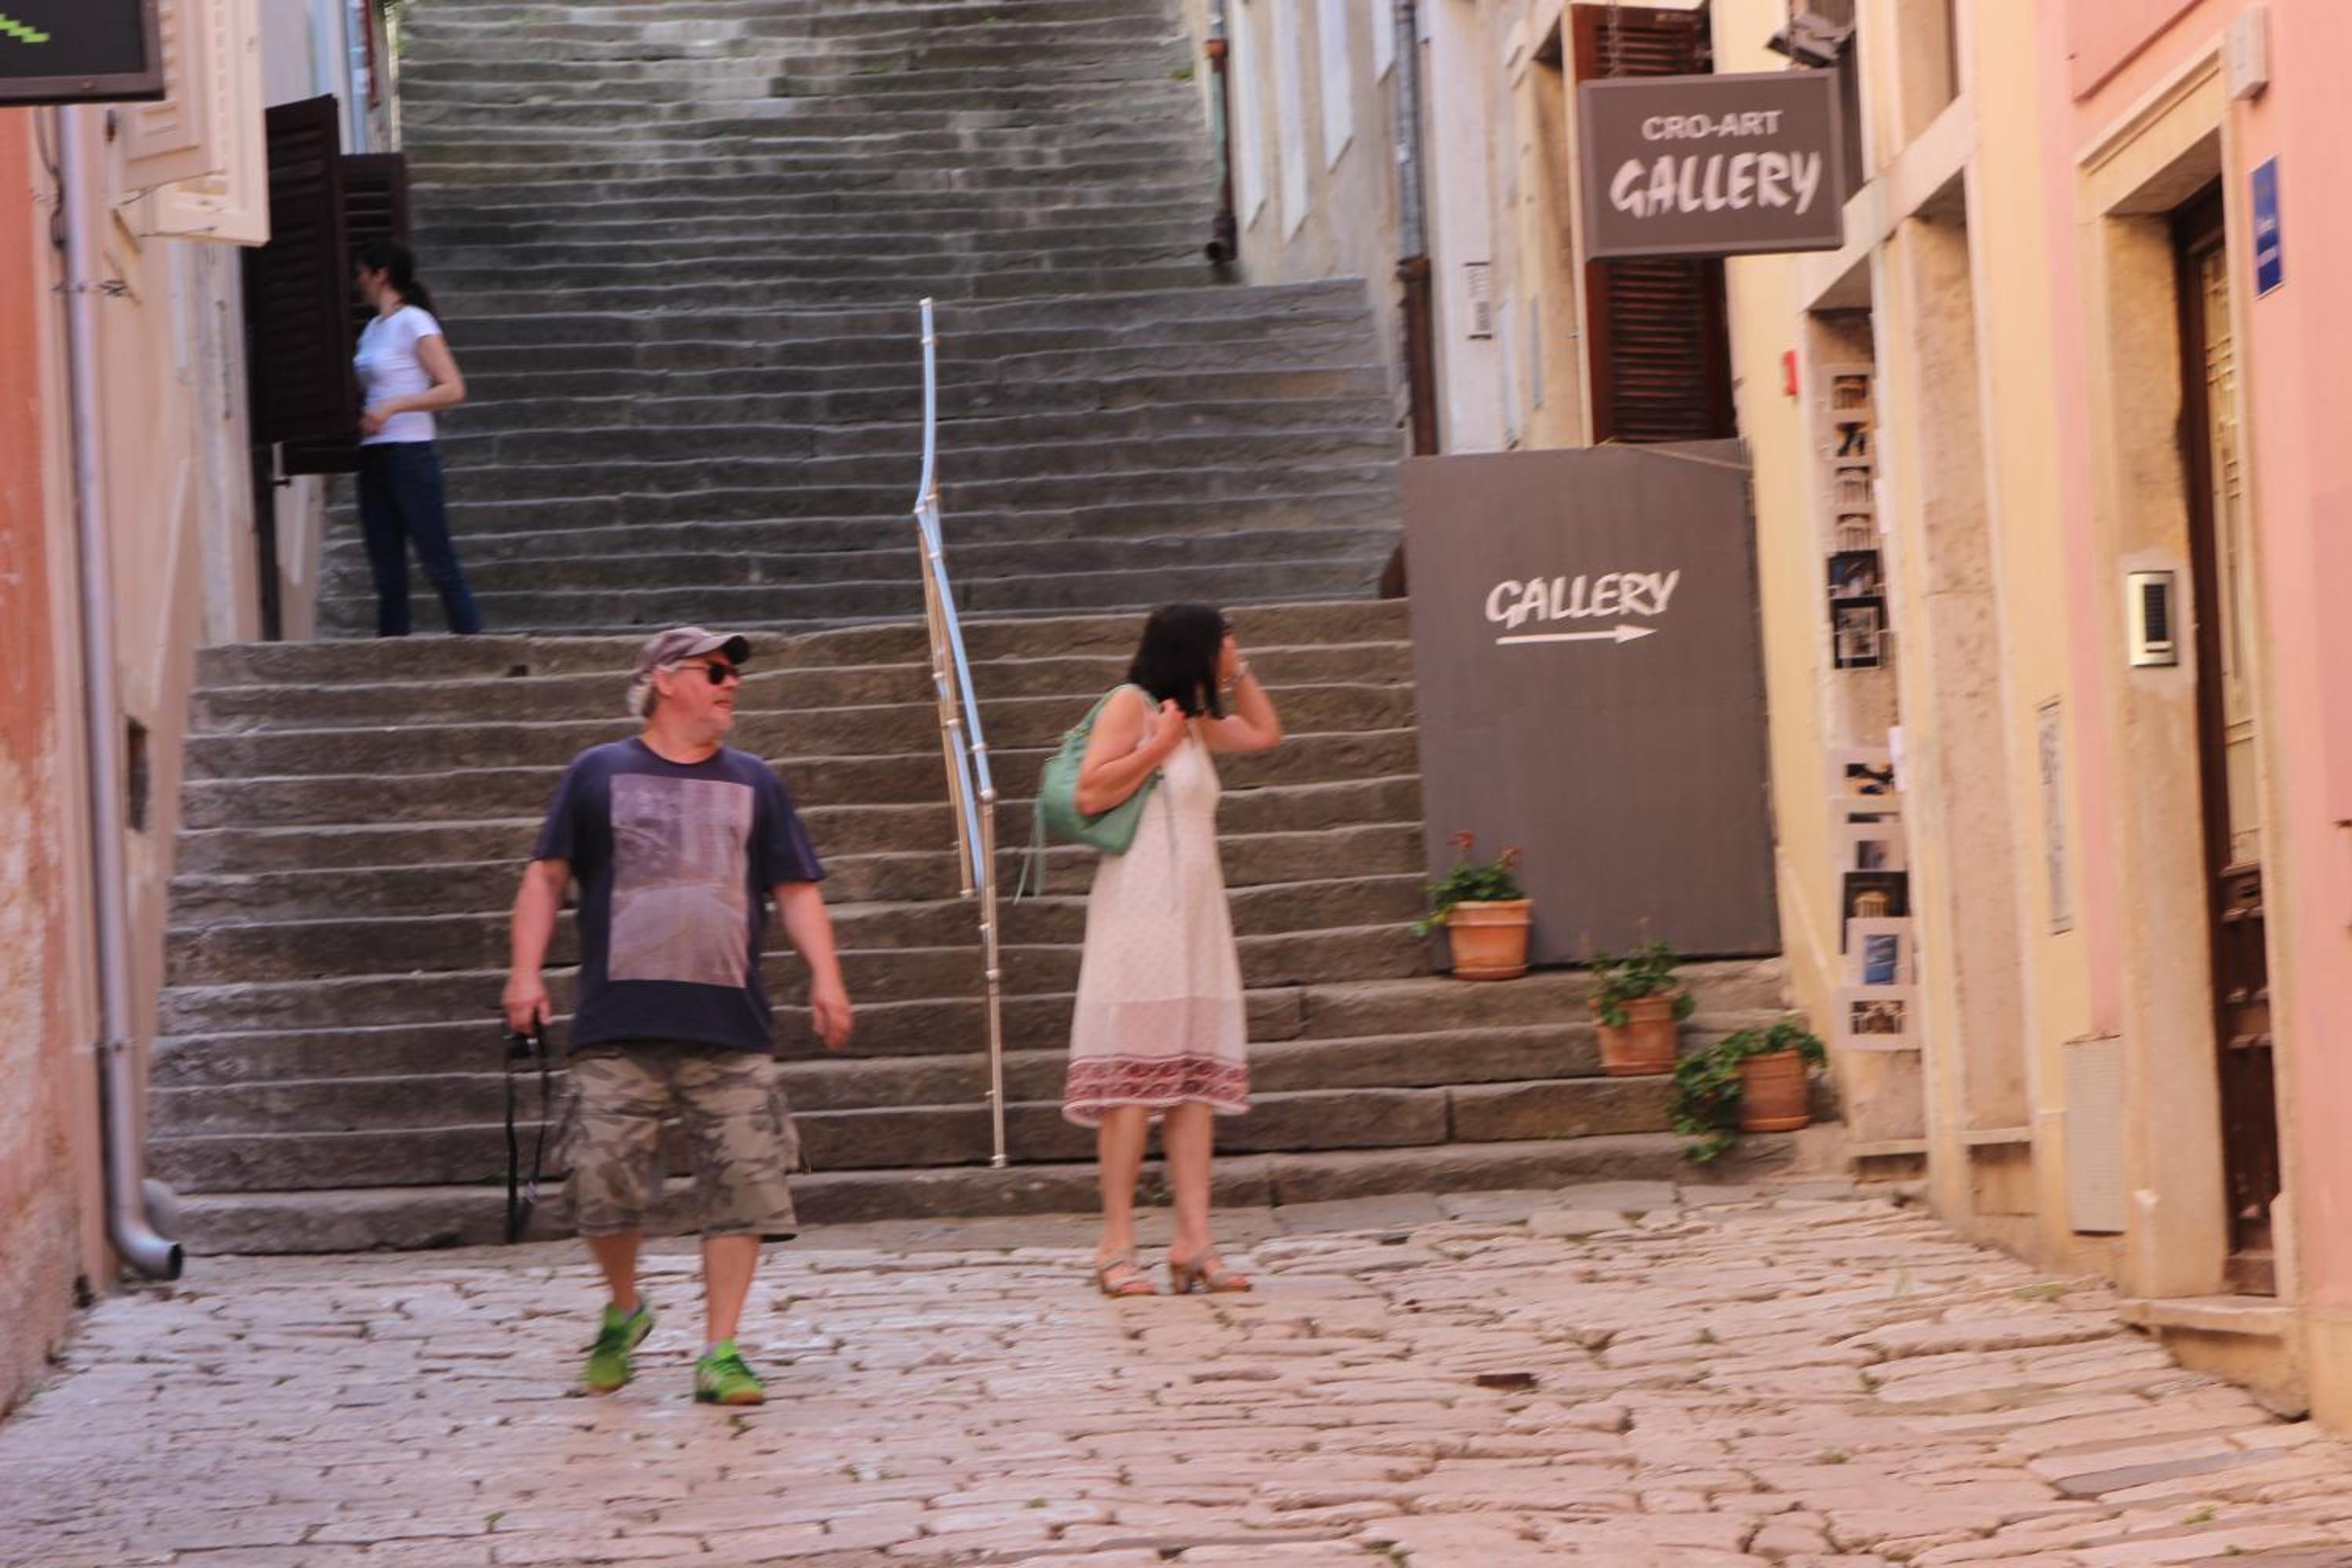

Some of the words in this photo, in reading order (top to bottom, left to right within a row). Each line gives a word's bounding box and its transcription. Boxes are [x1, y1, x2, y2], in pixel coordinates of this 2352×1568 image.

[1642, 110, 1782, 140] CRO-ART
[1610, 151, 1822, 218] GALLERY
[1486, 568, 1680, 629] GALLERY
